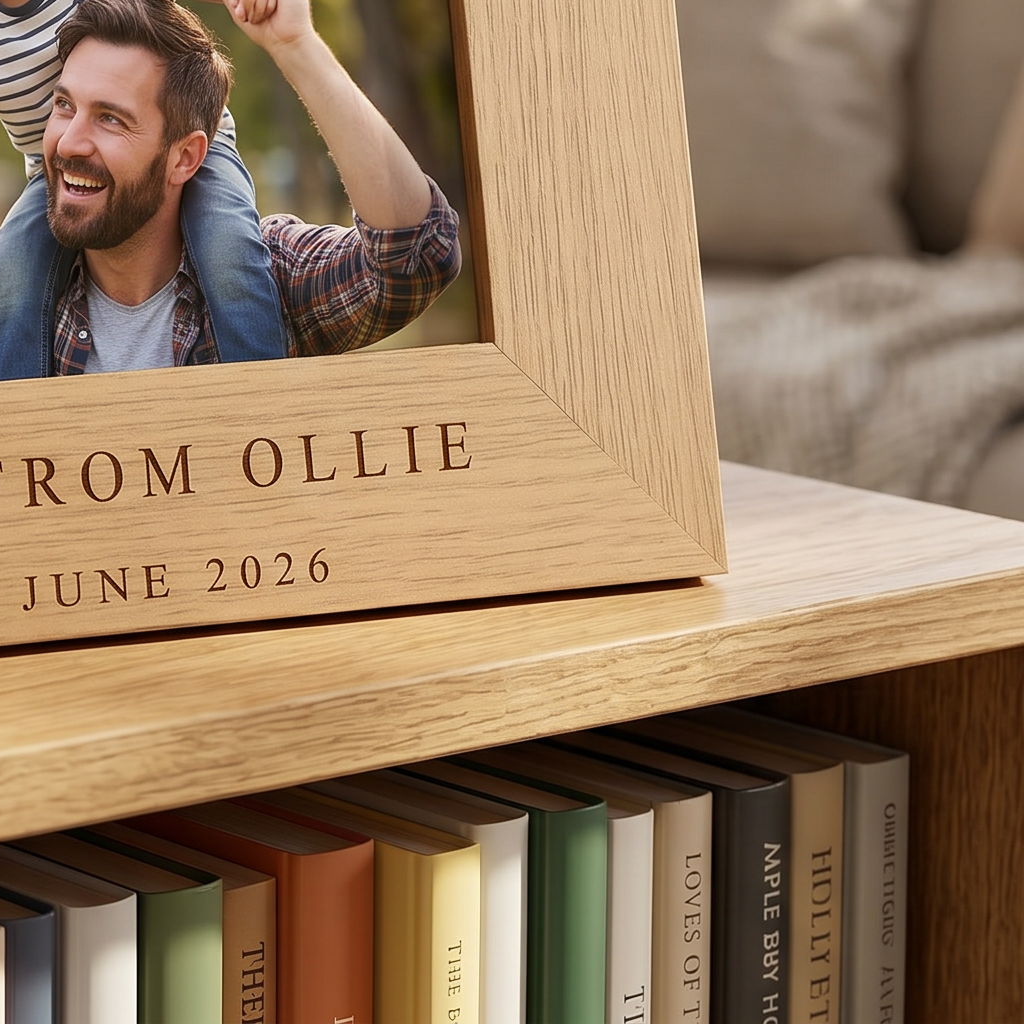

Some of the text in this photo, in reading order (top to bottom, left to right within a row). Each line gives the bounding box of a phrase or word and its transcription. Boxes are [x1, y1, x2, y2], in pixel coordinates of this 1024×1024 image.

[242, 421, 473, 488] OLLIE
[22, 564, 171, 612] JUNE
[205, 547, 330, 593] 2026
[683, 852, 703, 944] LOVES
[683, 954, 701, 991] OF
